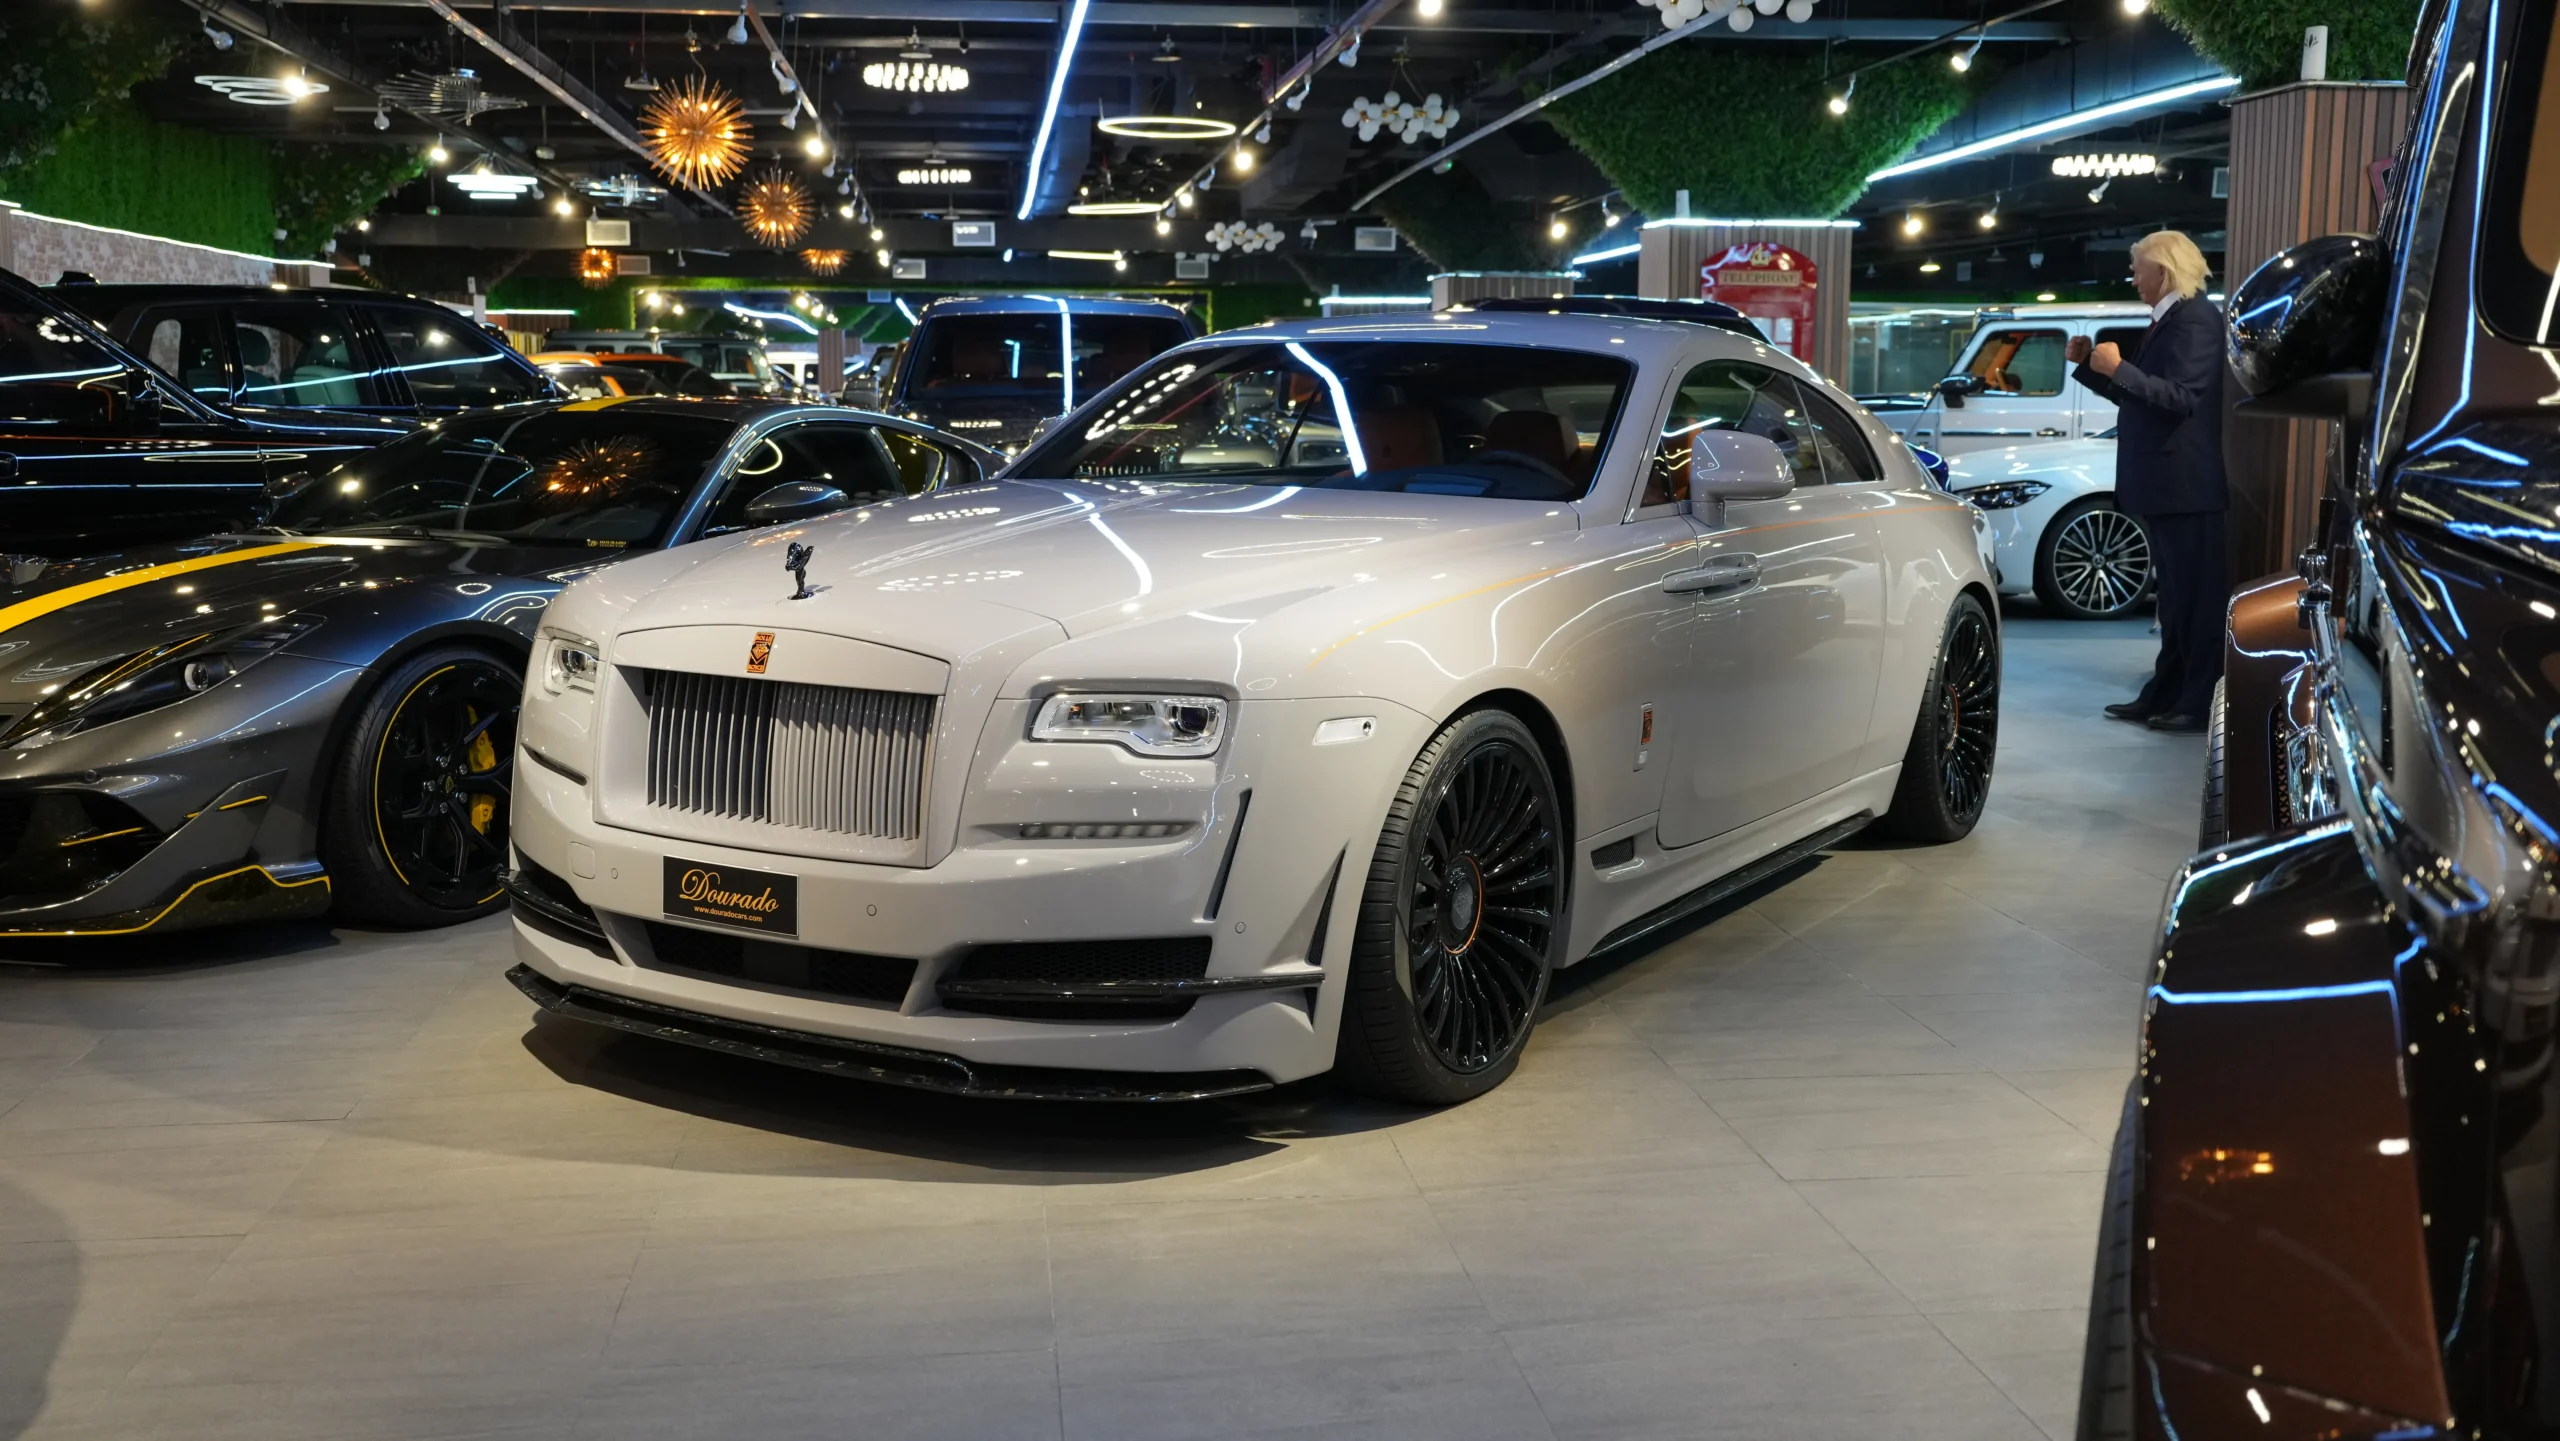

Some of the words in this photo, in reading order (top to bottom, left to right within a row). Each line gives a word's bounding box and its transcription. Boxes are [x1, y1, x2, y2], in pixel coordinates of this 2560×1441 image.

[1722, 271, 1797, 283] TELEPHONE
[679, 868, 779, 913] Dourado
[693, 905, 763, 923] www.douradocars.com
